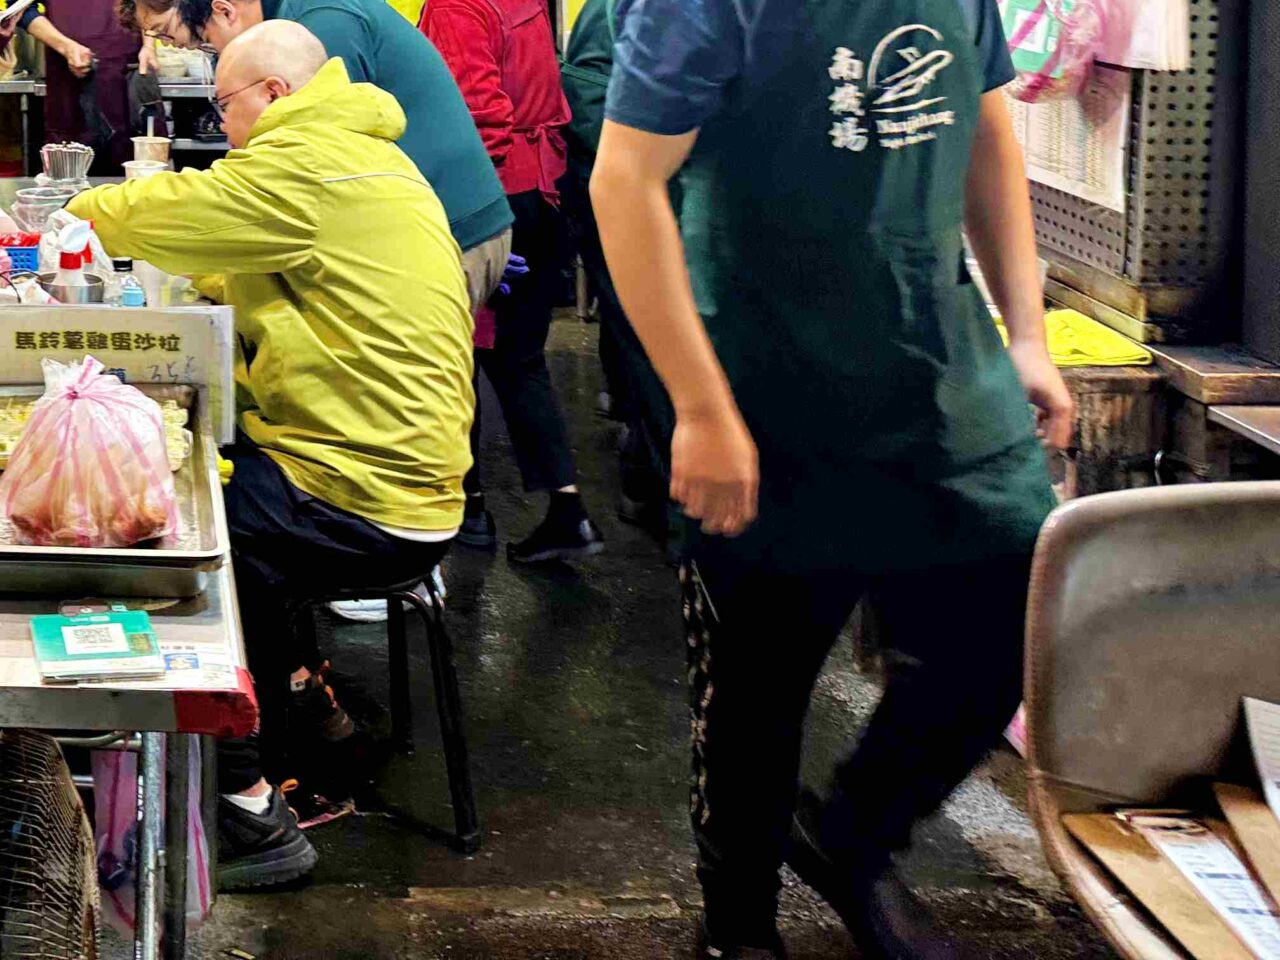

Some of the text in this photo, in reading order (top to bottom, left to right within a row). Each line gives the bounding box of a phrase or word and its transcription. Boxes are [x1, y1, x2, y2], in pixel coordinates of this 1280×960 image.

[15, 330, 182, 353] 馬鈴薯雞蛋沙拉
